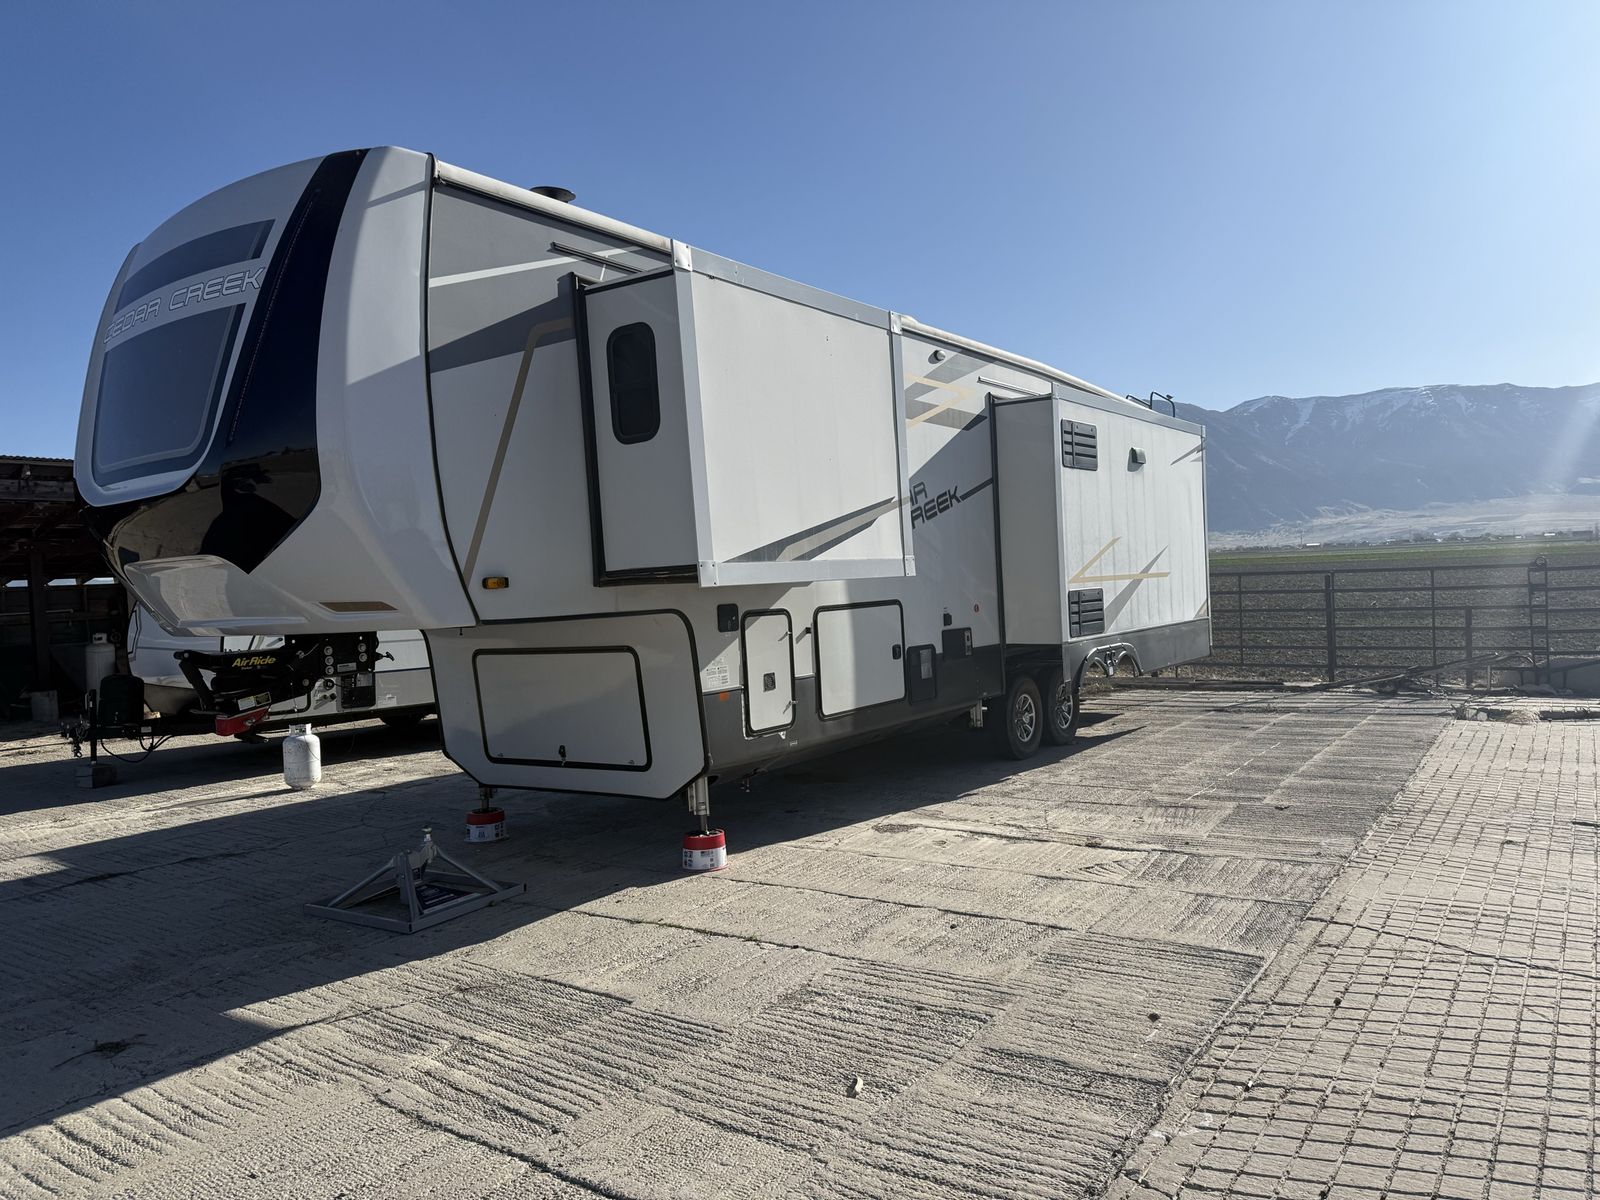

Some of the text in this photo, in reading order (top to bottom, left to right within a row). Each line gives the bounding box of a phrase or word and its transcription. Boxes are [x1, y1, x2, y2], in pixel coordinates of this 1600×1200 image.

[103, 267, 266, 344] CEDAR CREEK
[910, 485, 961, 530] REEK
